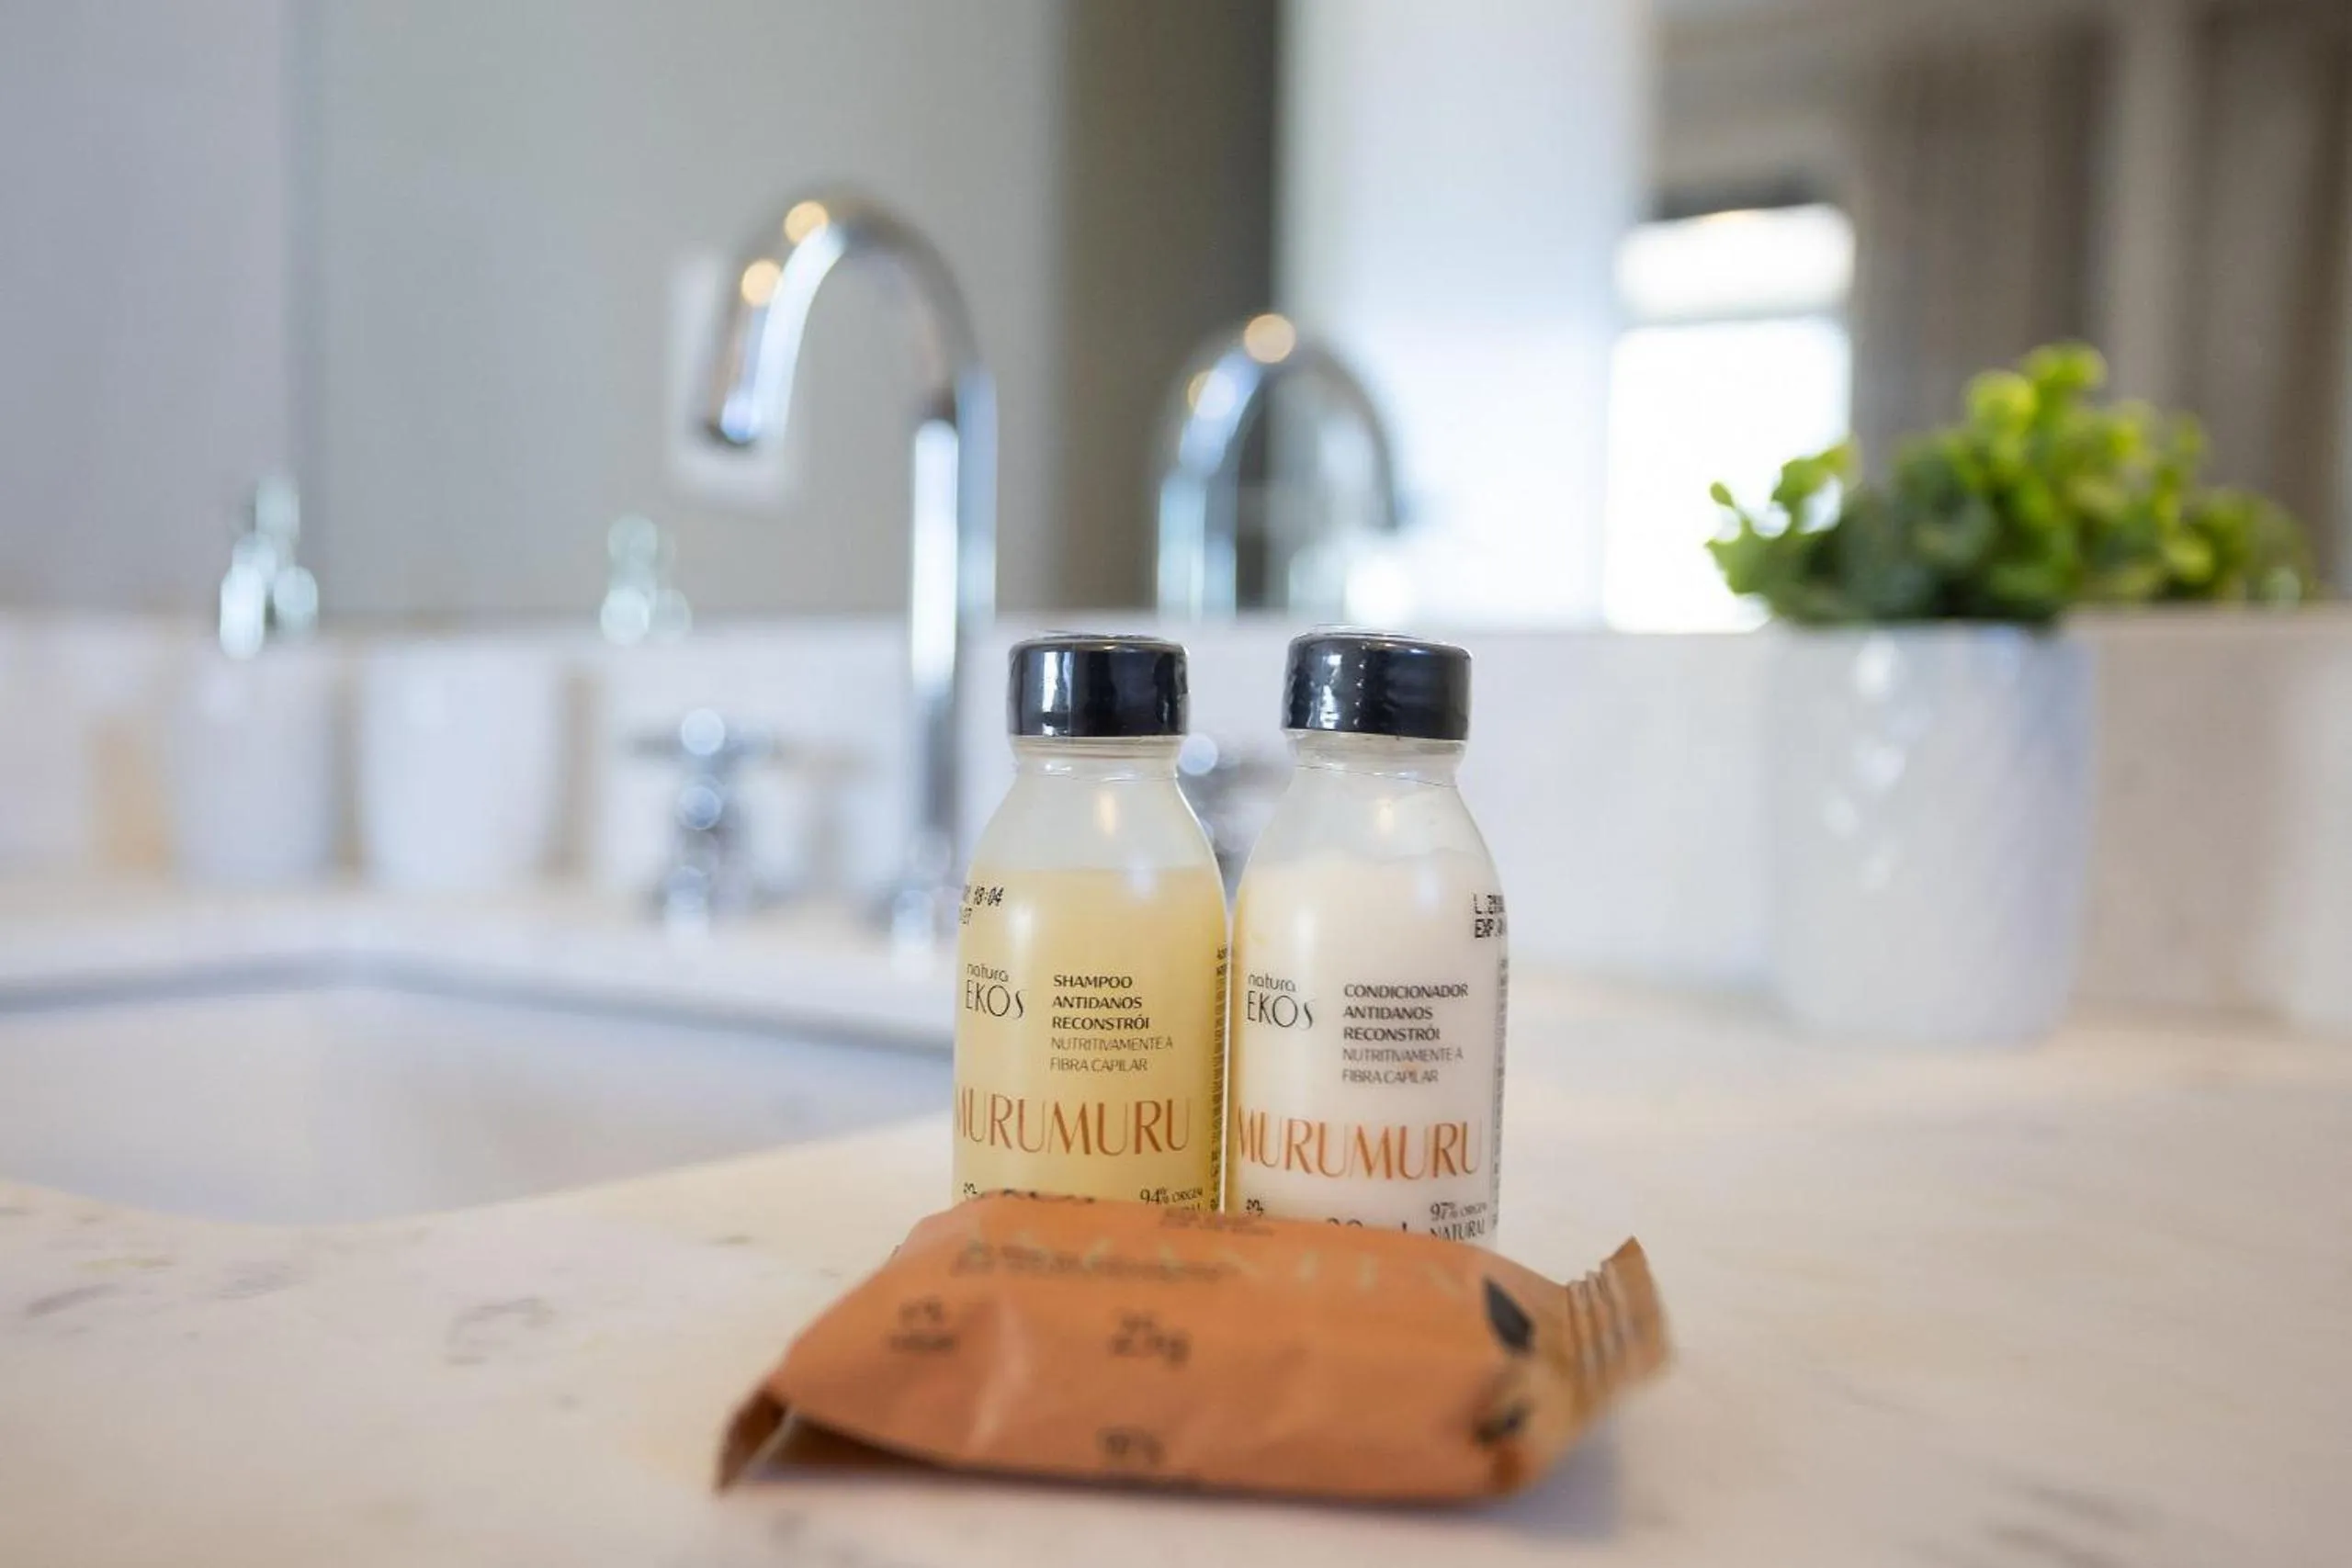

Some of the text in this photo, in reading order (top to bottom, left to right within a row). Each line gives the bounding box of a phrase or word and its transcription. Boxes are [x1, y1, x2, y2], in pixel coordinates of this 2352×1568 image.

[967, 964, 1009, 982] natura
[1053, 975, 1133, 988] SHAMPOO
[1248, 972, 1295, 992] natura
[966, 979, 1027, 1019] EKOS
[1343, 984, 1469, 998] CONDICIONADOR
[1052, 996, 1142, 1010] ANTIDANOS
[1247, 990, 1317, 1030] EKOS
[1342, 1006, 1433, 1020] ANTIDANOS
[1051, 1015, 1150, 1031] RECONSTRÓI
[1343, 1024, 1441, 1042] RECONSTRÓI
[1050, 1037, 1163, 1052] NUTRITIVAMENTE
[1342, 1047, 1452, 1063] NUTRITIVAMENTE
[1050, 1058, 1148, 1072] FIBRA CAPILAR
[1342, 1069, 1440, 1085] FIBRA CAPILAR
